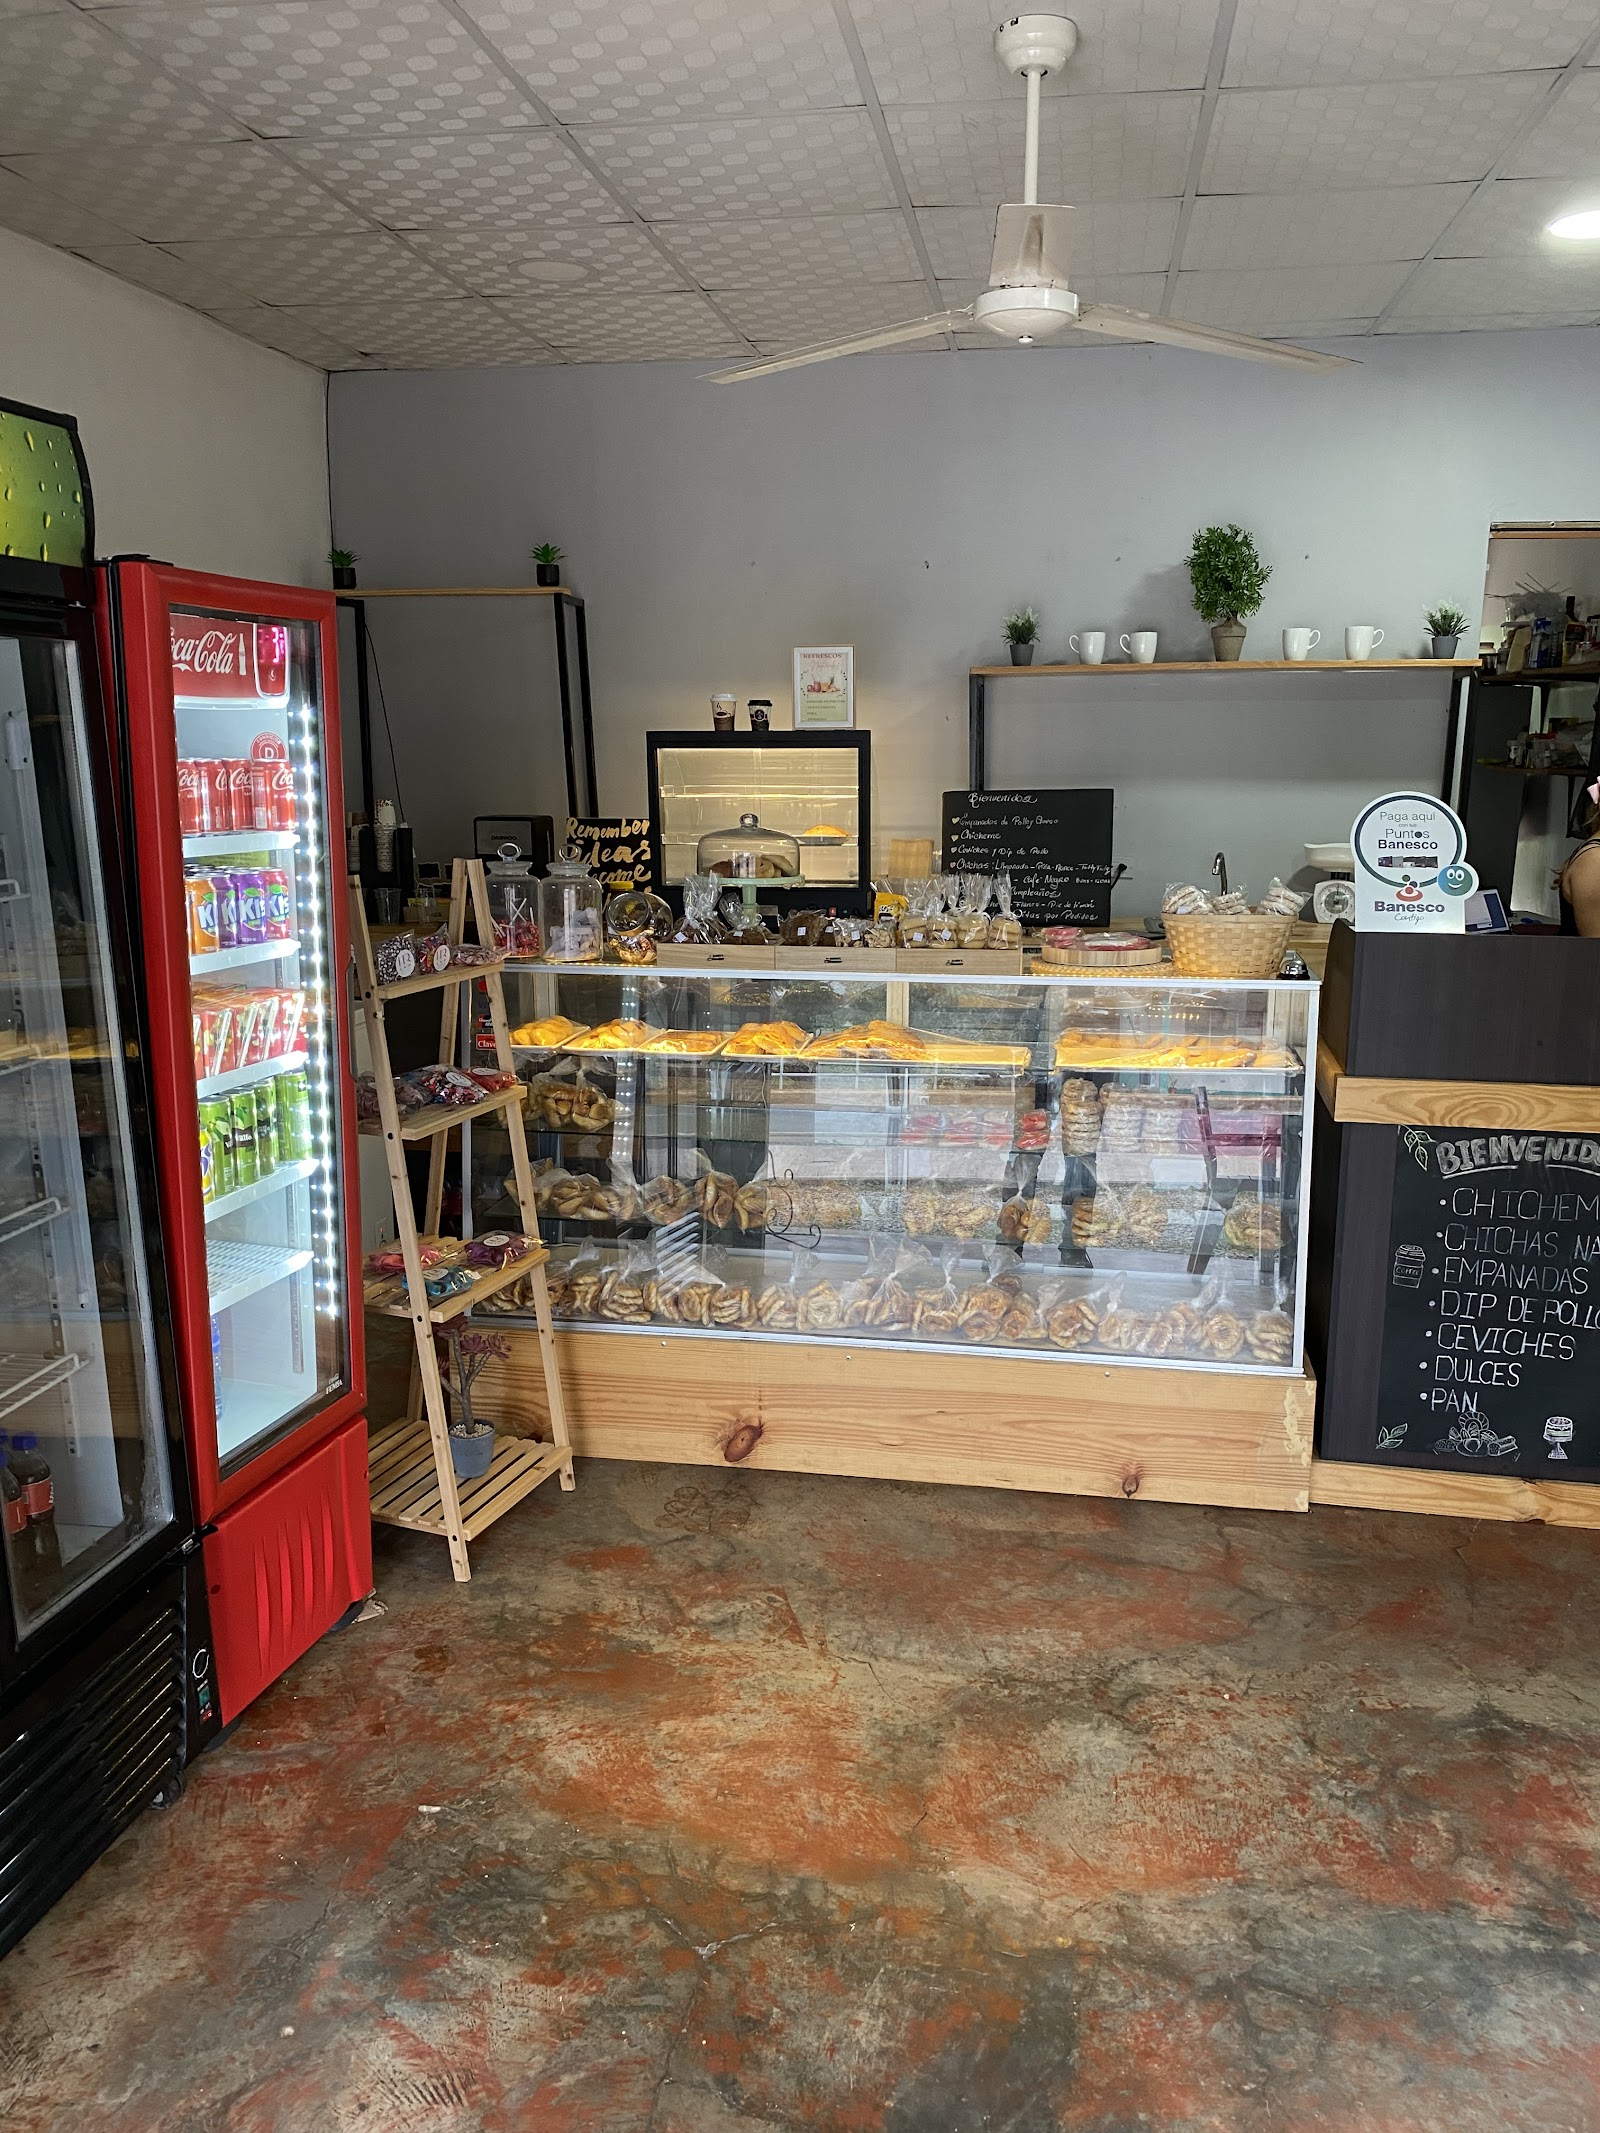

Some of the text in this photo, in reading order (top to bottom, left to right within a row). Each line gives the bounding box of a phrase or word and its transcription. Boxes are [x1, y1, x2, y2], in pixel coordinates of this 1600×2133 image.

[264, 747, 274, 759] D
[1380, 811, 1436, 822] Paga aquí
[566, 817, 650, 840] Remember
[960, 829, 1002, 840] Chicheme
[1378, 839, 1438, 850] Banesco
[591, 864, 651, 884] ecome
[1374, 901, 1445, 912] Banesco
[1394, 913, 1425, 925] Contigo
[1444, 1222, 1559, 1258] CHICHAS
[1443, 1256, 1590, 1295] EMPANADAS
[1440, 1289, 1498, 1320] DIP
[1507, 1295, 1536, 1324] DE
[1437, 1322, 1576, 1361] CEVICHES
[1434, 1355, 1523, 1388] DULCES
[1430, 1387, 1478, 1414] PAN
